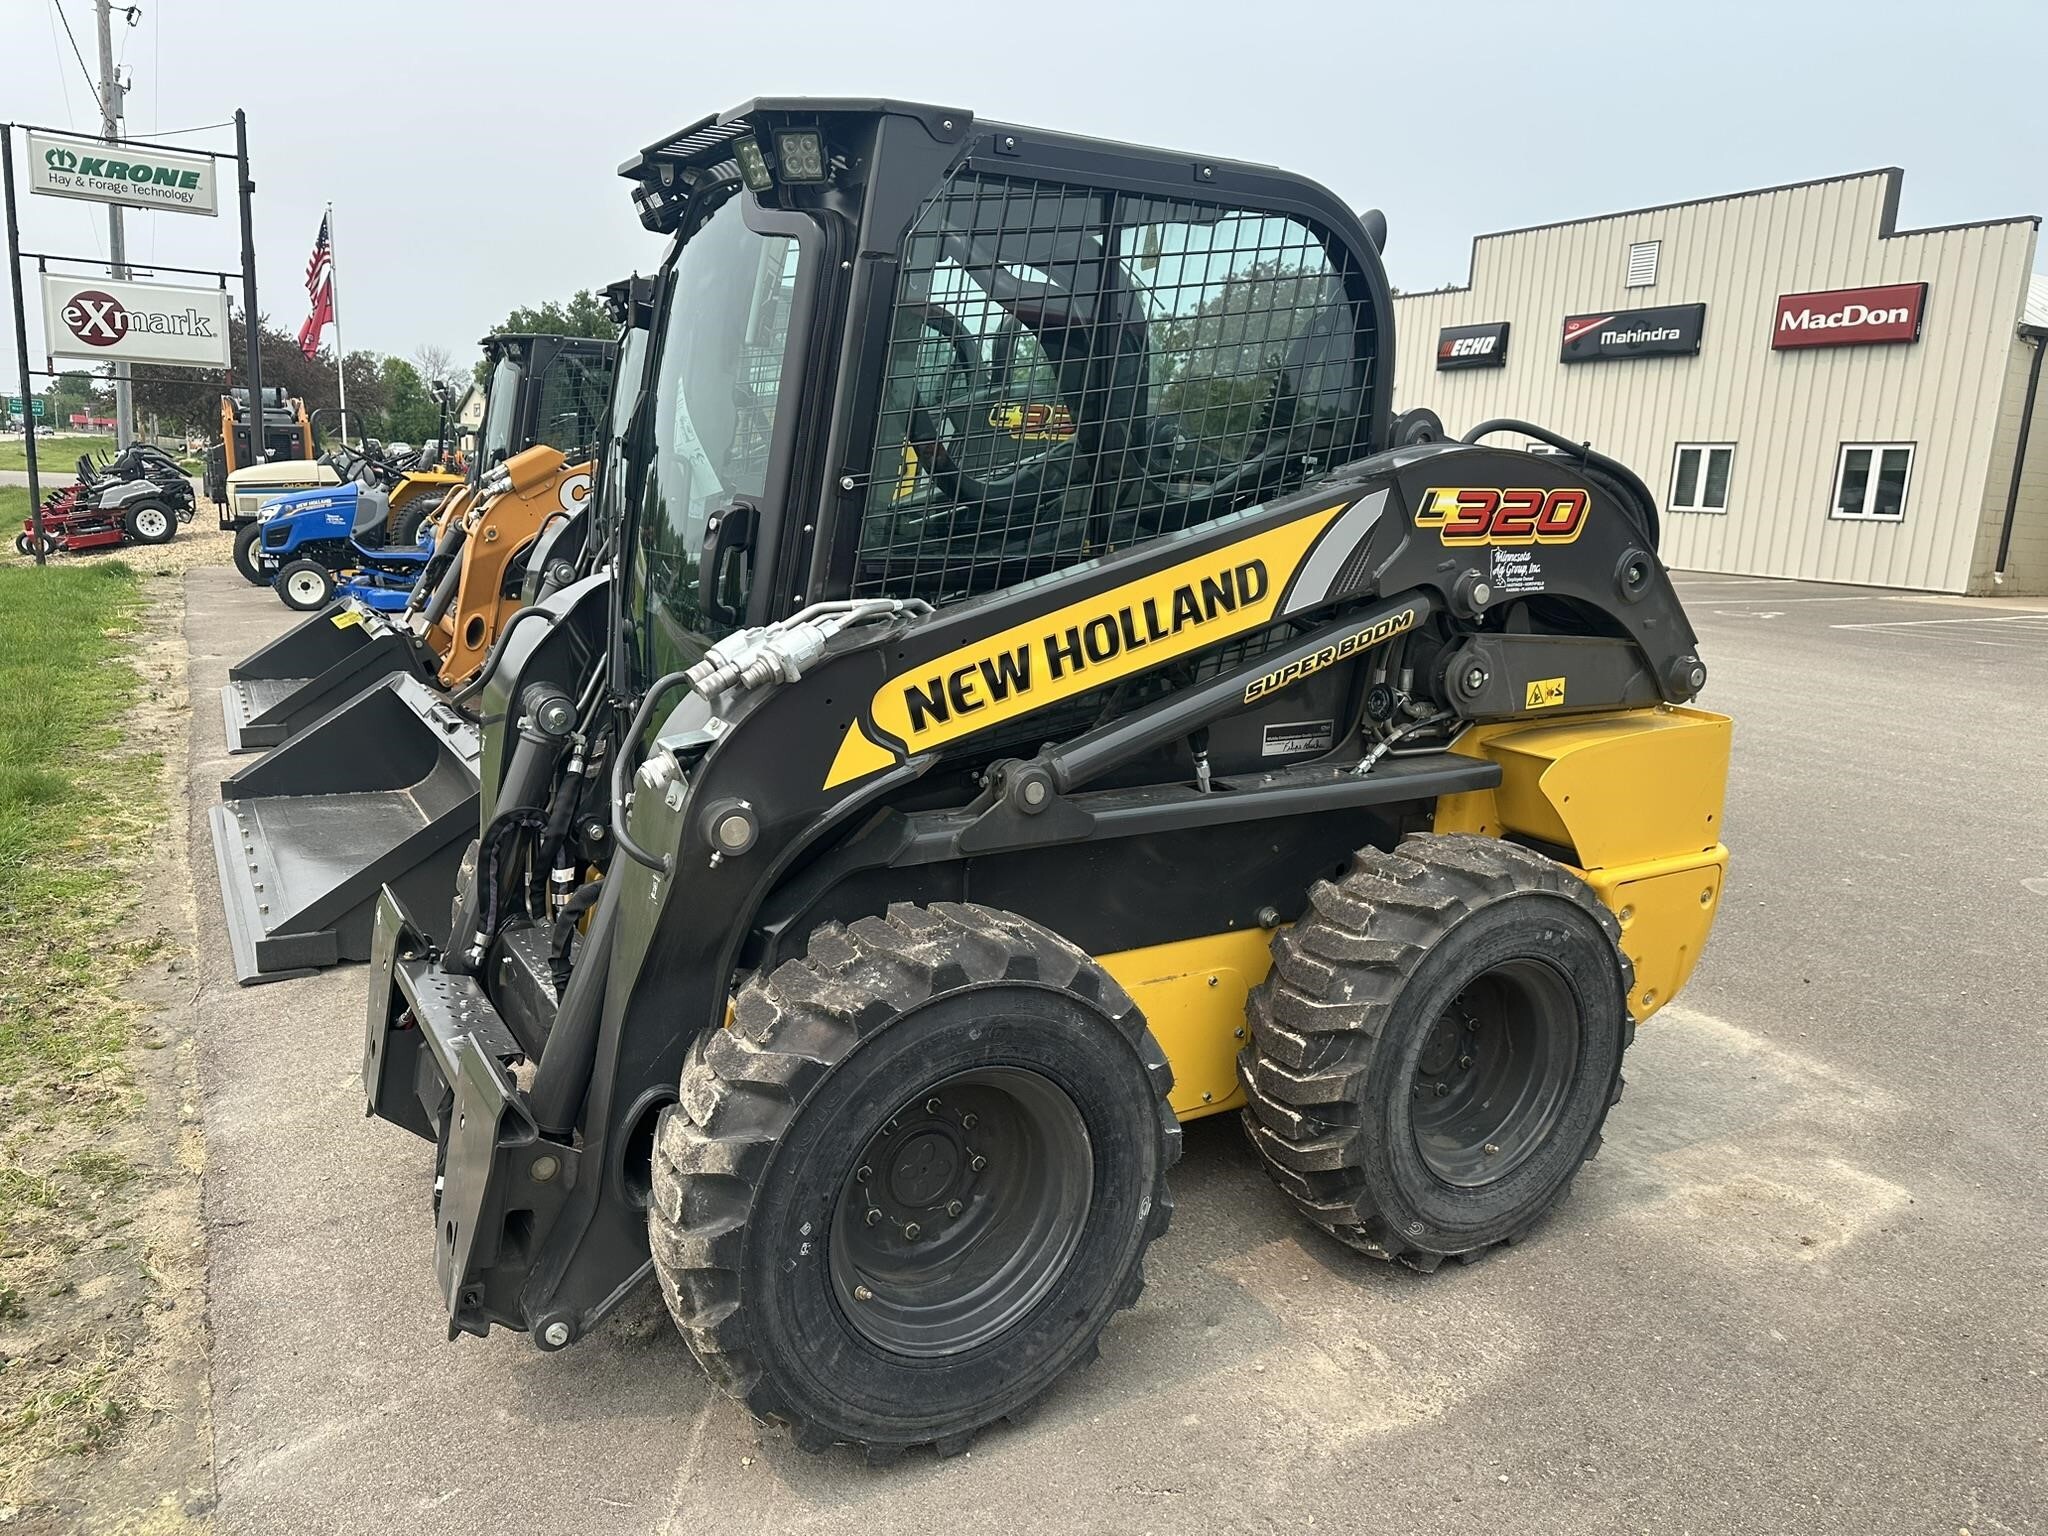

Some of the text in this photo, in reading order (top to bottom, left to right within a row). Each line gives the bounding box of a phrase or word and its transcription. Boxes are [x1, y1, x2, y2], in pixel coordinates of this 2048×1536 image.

[48, 172, 194, 203] Hay & Forage Technology
[78, 157, 201, 190] KRONE
[61, 299, 214, 339] eXmark
[1780, 305, 1909, 331] MacDon
[1450, 336, 1496, 356] ECHO
[1600, 327, 1680, 345] Mahindra
[1415, 488, 1590, 545] L320
[1494, 551, 1532, 562] Minnesota
[903, 558, 1269, 735] NEW HOLLAND
[1244, 609, 1414, 704] SUPER BOOM
